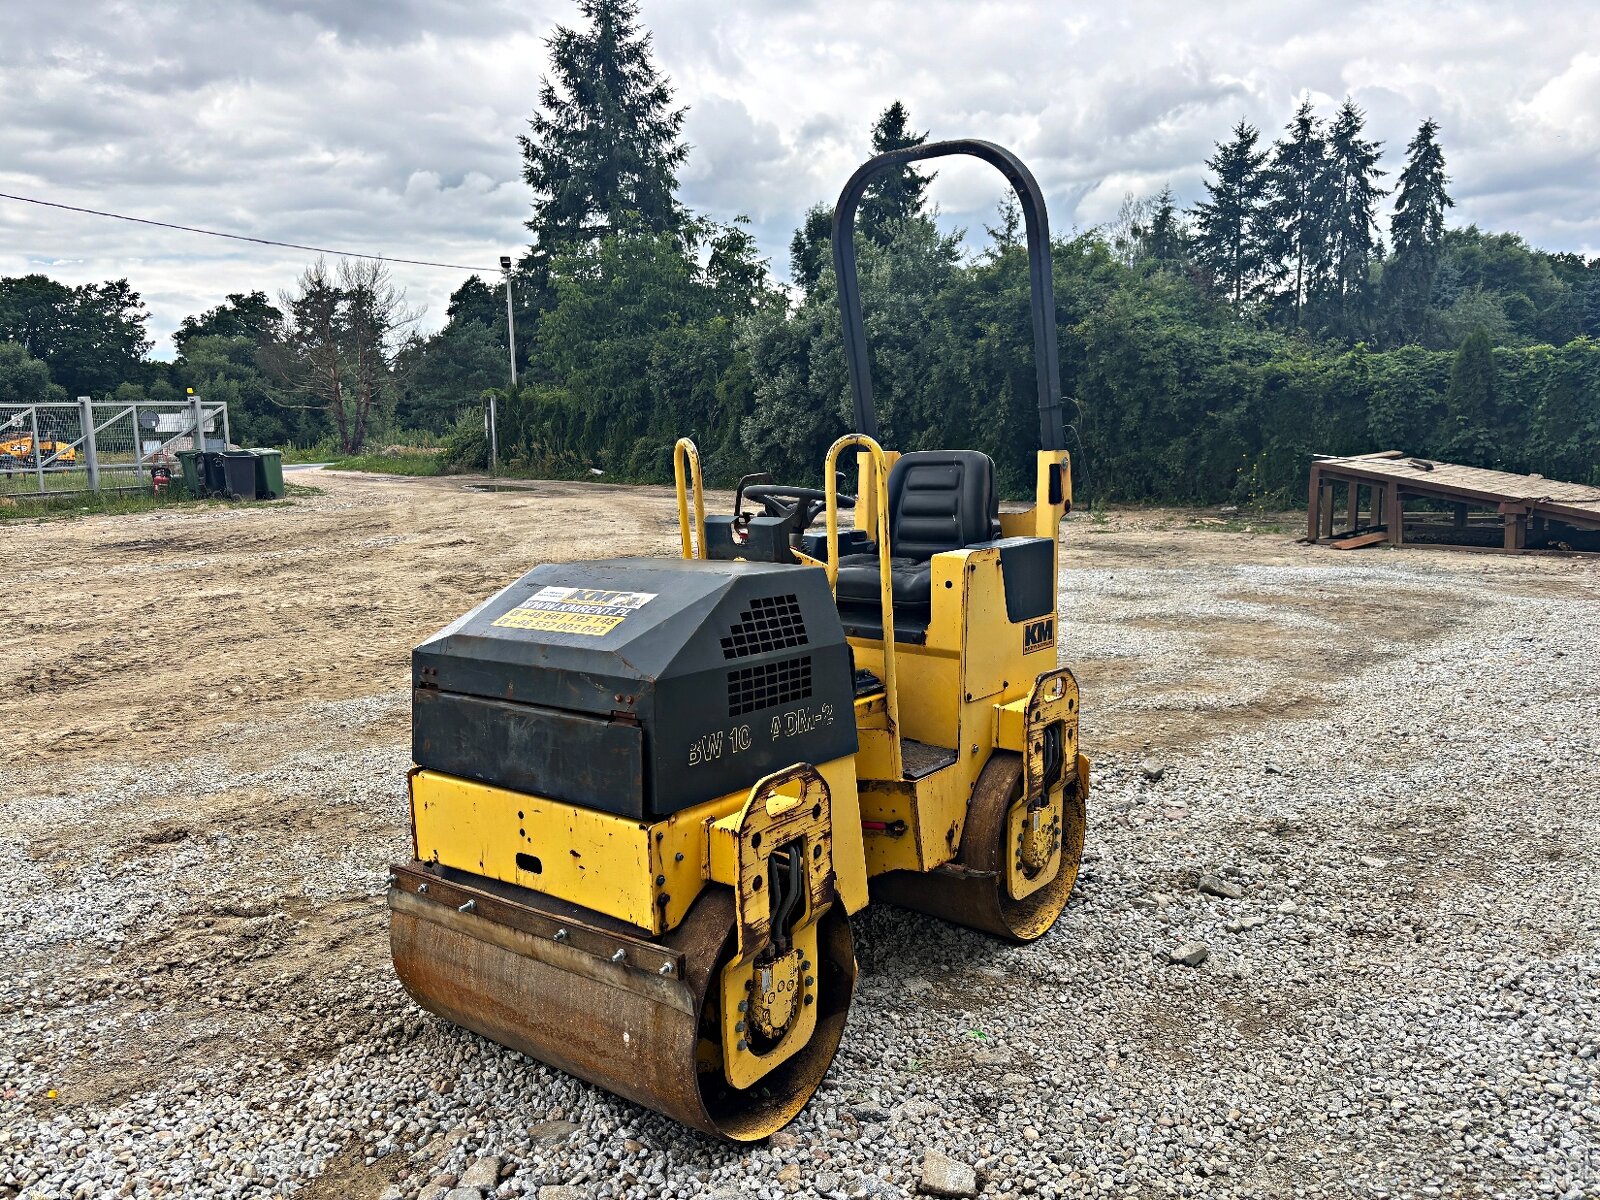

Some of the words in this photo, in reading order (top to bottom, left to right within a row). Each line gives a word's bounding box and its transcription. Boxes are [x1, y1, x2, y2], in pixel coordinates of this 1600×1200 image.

[568, 590, 619, 602] KM
[520, 601, 633, 618] WWW.KMRENT.PL
[1025, 620, 1053, 646] KM
[688, 730, 724, 766] BW
